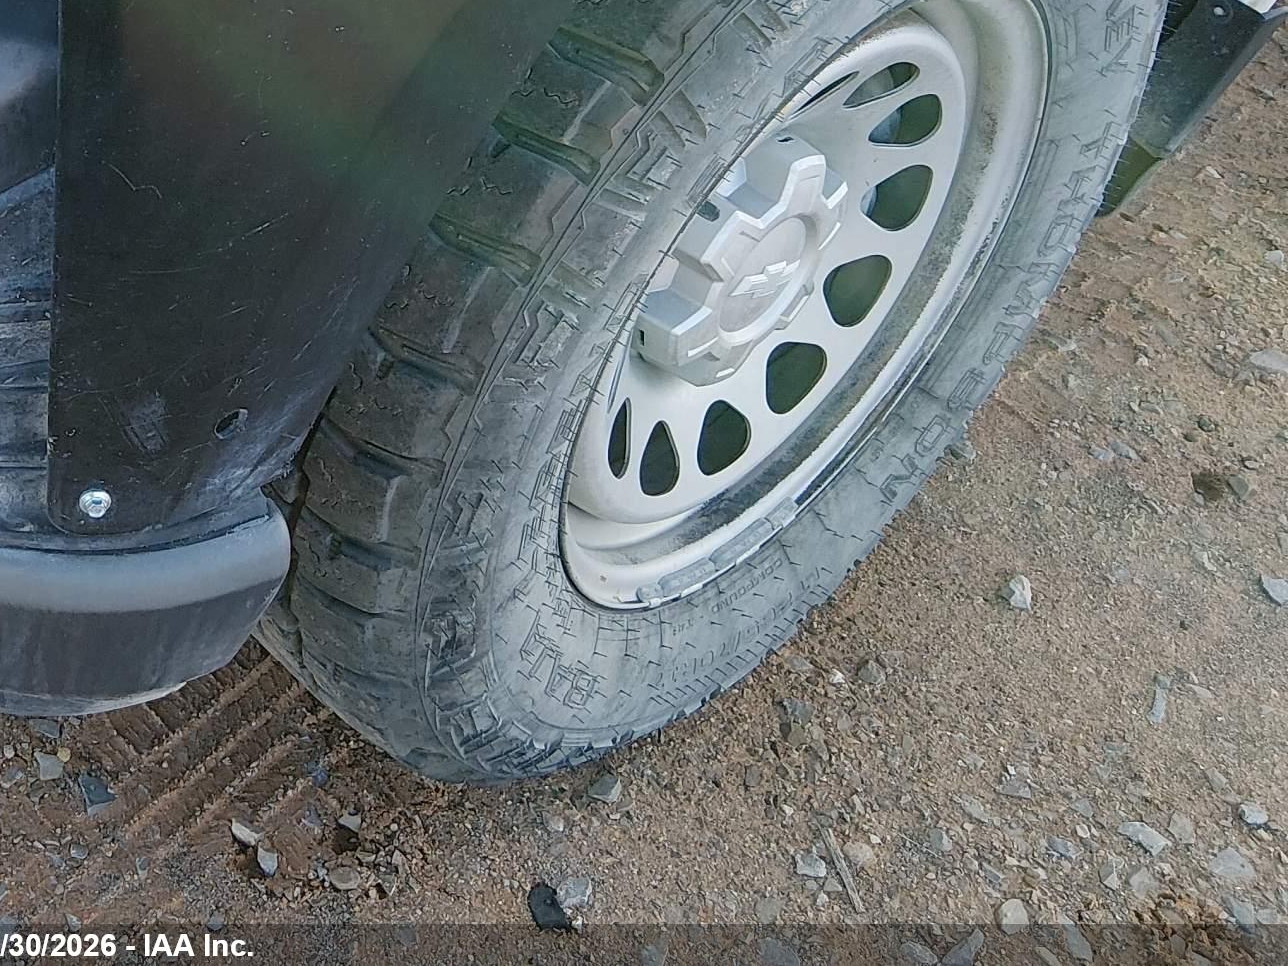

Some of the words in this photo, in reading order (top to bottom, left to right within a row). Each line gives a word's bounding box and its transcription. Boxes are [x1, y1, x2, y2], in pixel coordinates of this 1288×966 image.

[878, 120, 1112, 504] THOMPSON
[712, 557, 784, 615] COMPOUND
[519, 609, 599, 710] BAJA
